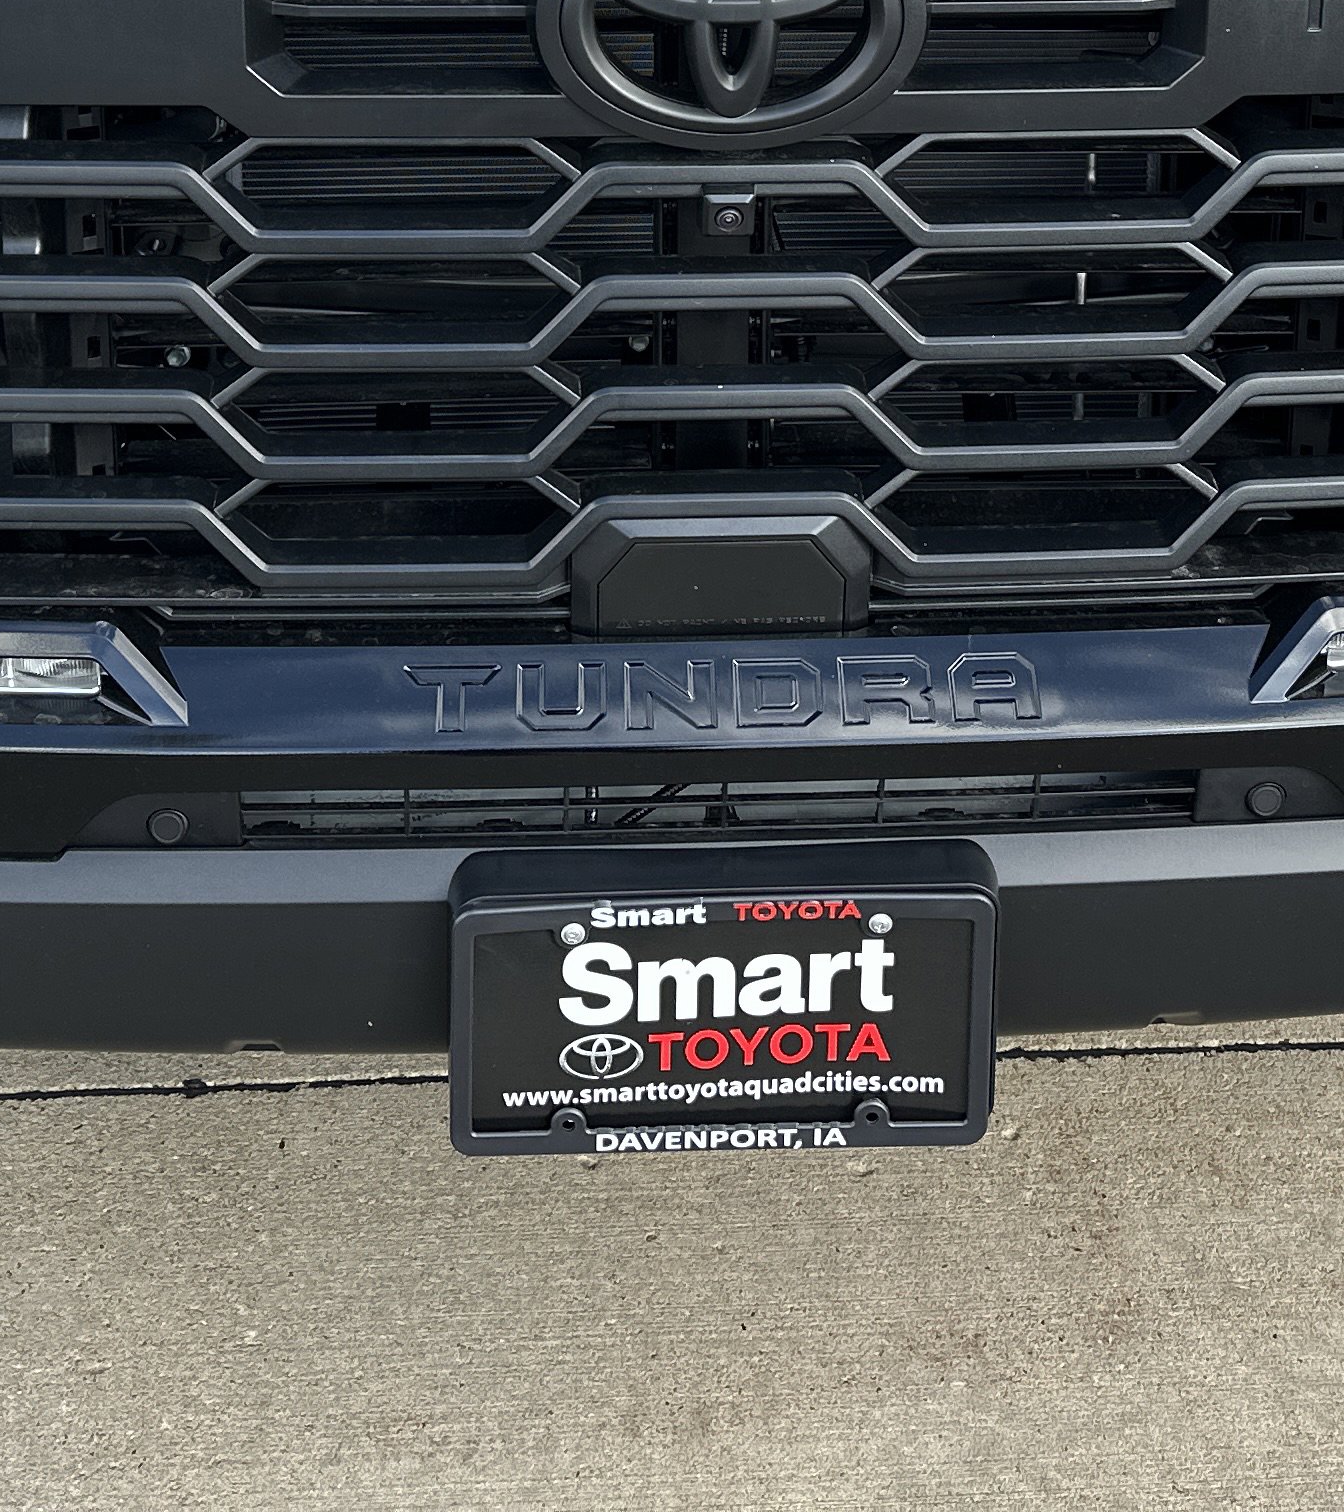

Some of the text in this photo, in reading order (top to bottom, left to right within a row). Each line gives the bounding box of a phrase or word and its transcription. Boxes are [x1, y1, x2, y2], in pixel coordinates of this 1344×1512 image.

[402, 651, 1043, 734] TUNDRA
[590, 900, 862, 928] Smart TOYOTA
[558, 938, 895, 1026] Smart
[648, 1022, 891, 1072] TOYOTA
[502, 1071, 944, 1107] www.smarttoyotaquadcities.com
[594, 1128, 847, 1153] DAVENPORT, IA
